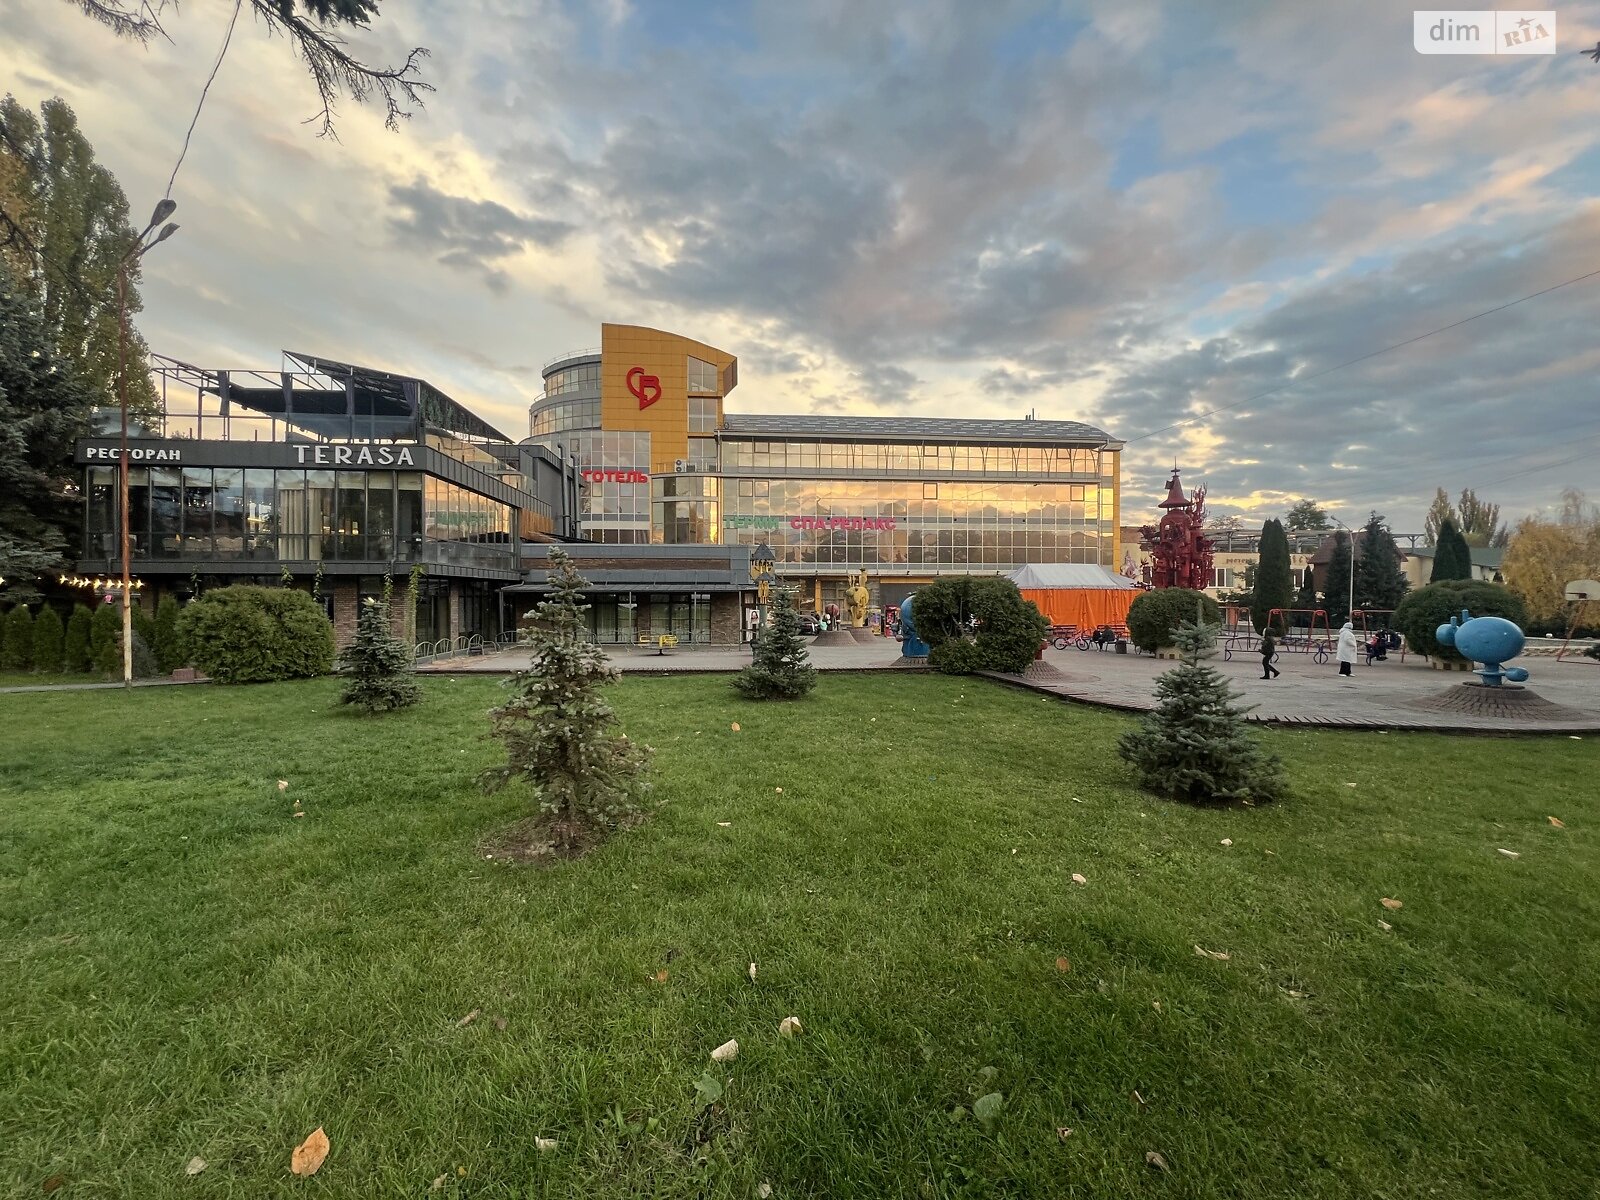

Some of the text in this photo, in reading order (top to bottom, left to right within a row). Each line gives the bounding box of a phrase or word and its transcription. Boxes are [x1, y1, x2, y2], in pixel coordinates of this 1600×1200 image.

[292, 444, 414, 465] TERASA
[582, 469, 648, 483] ГОТЕЛЬ
[790, 516, 897, 531] СПА-РЕЛАКС
